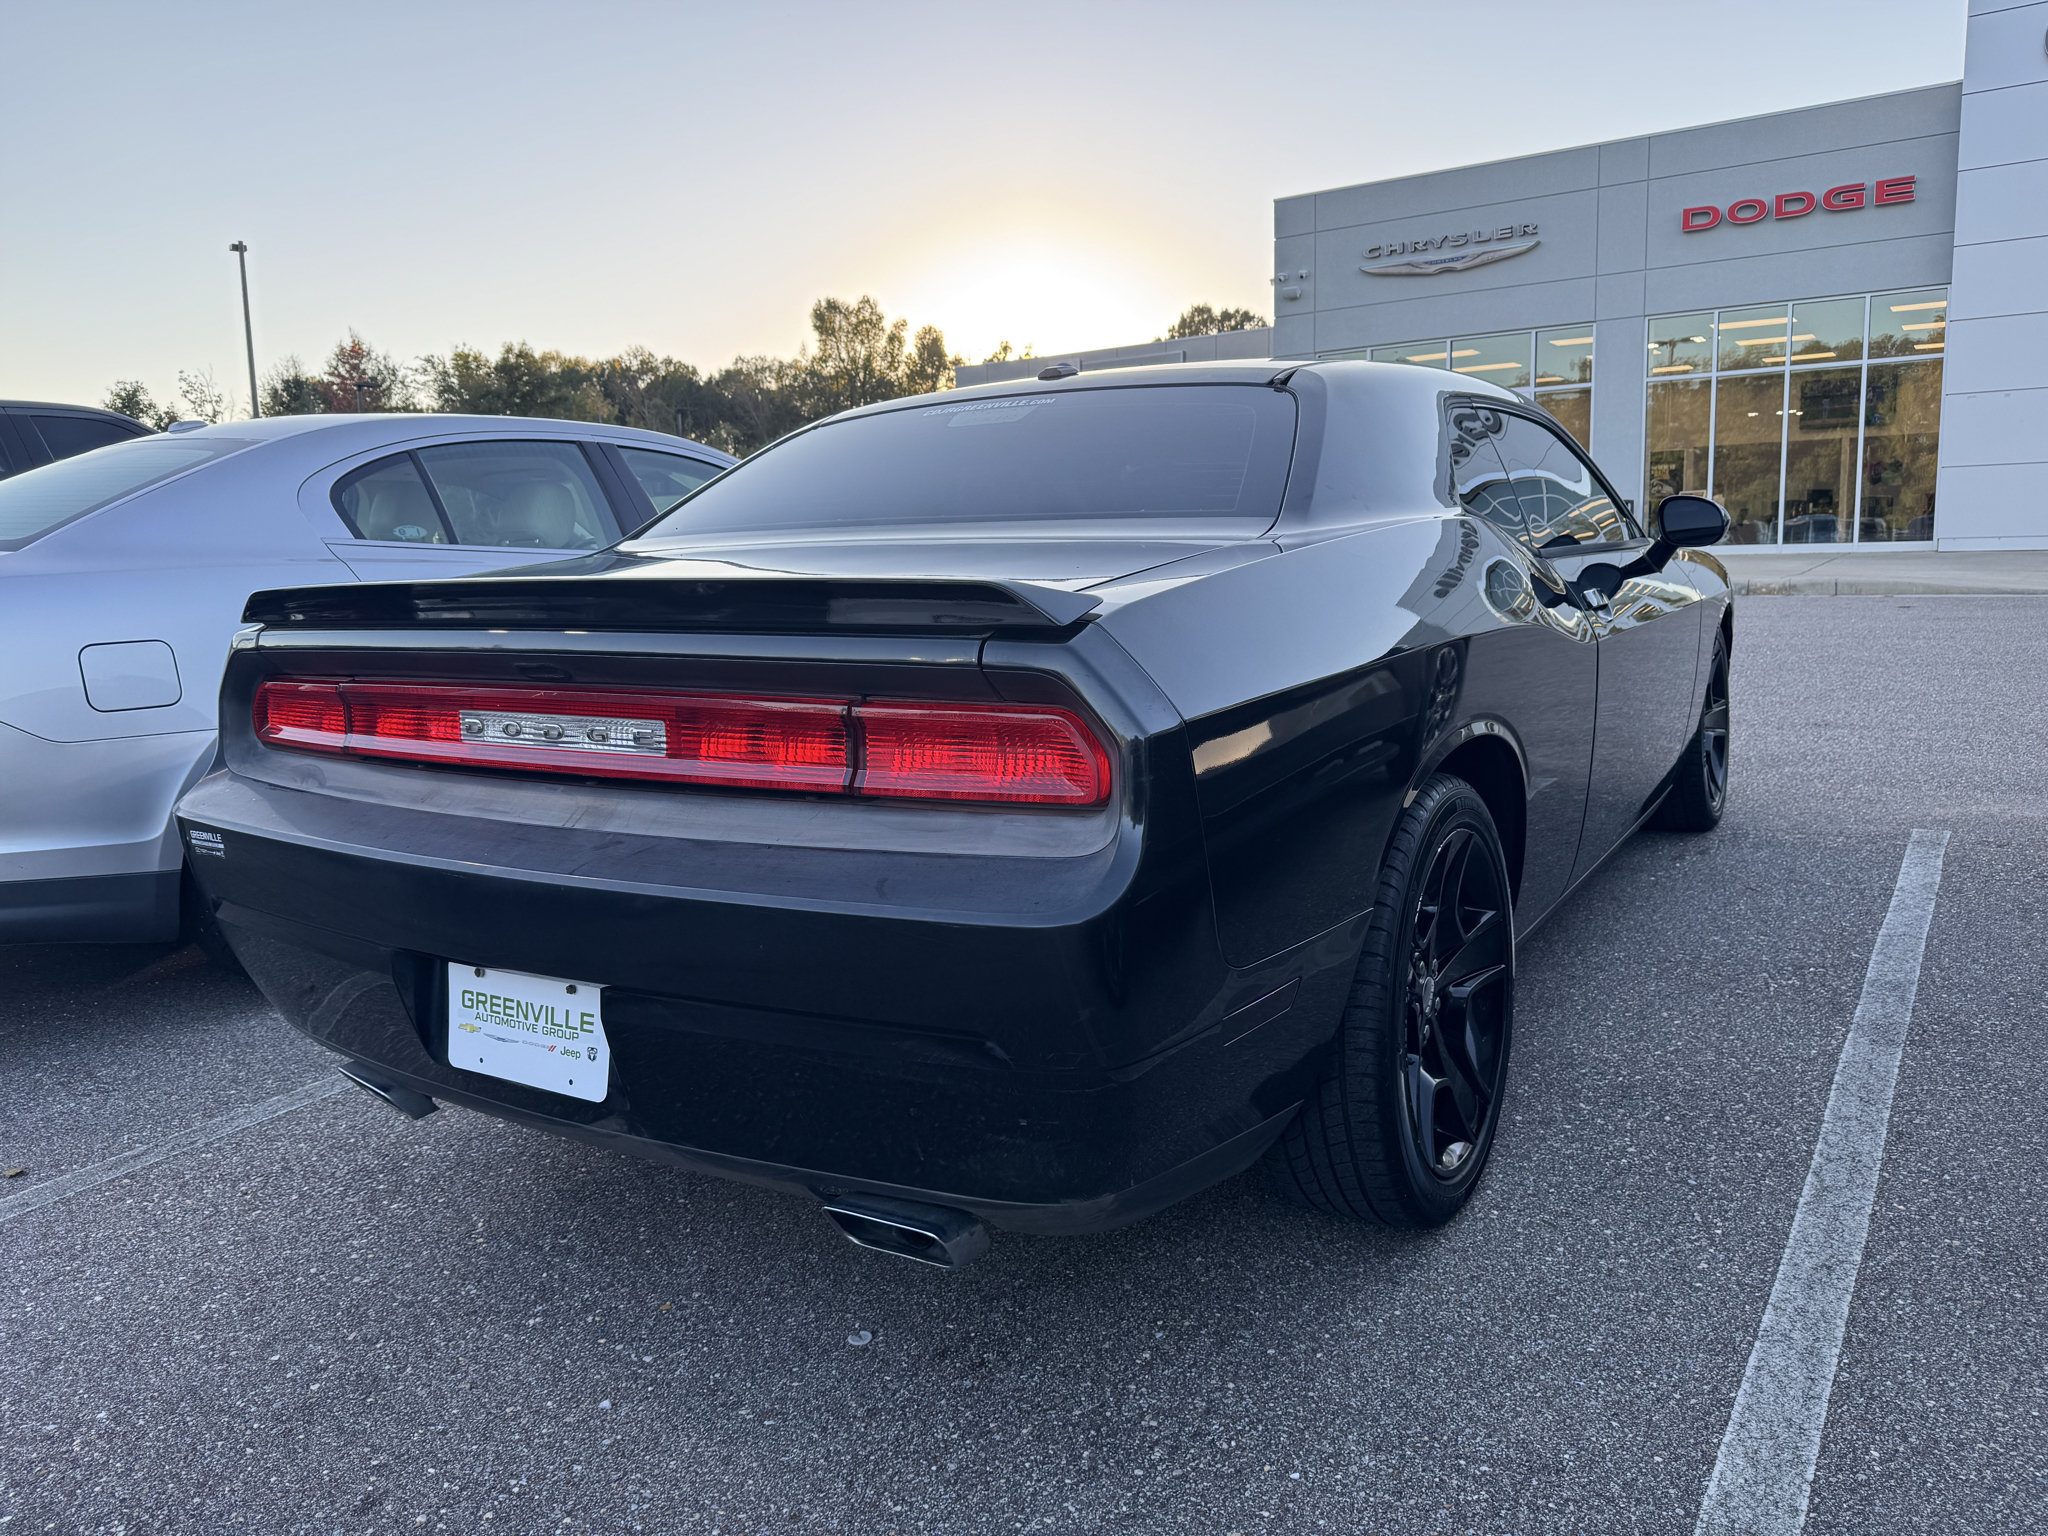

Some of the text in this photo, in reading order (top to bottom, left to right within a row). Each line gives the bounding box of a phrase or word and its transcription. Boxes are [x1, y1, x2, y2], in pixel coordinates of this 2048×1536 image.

[1682, 175, 1916, 231] DODGE
[1362, 223, 1538, 259] CHRYSLER
[464, 718, 655, 746] DODGE
[461, 989, 595, 1034] GREENVILLE
[474, 1012, 579, 1041] AUTOMOTIVE GROUP
[560, 1046, 581, 1060] Jeep
